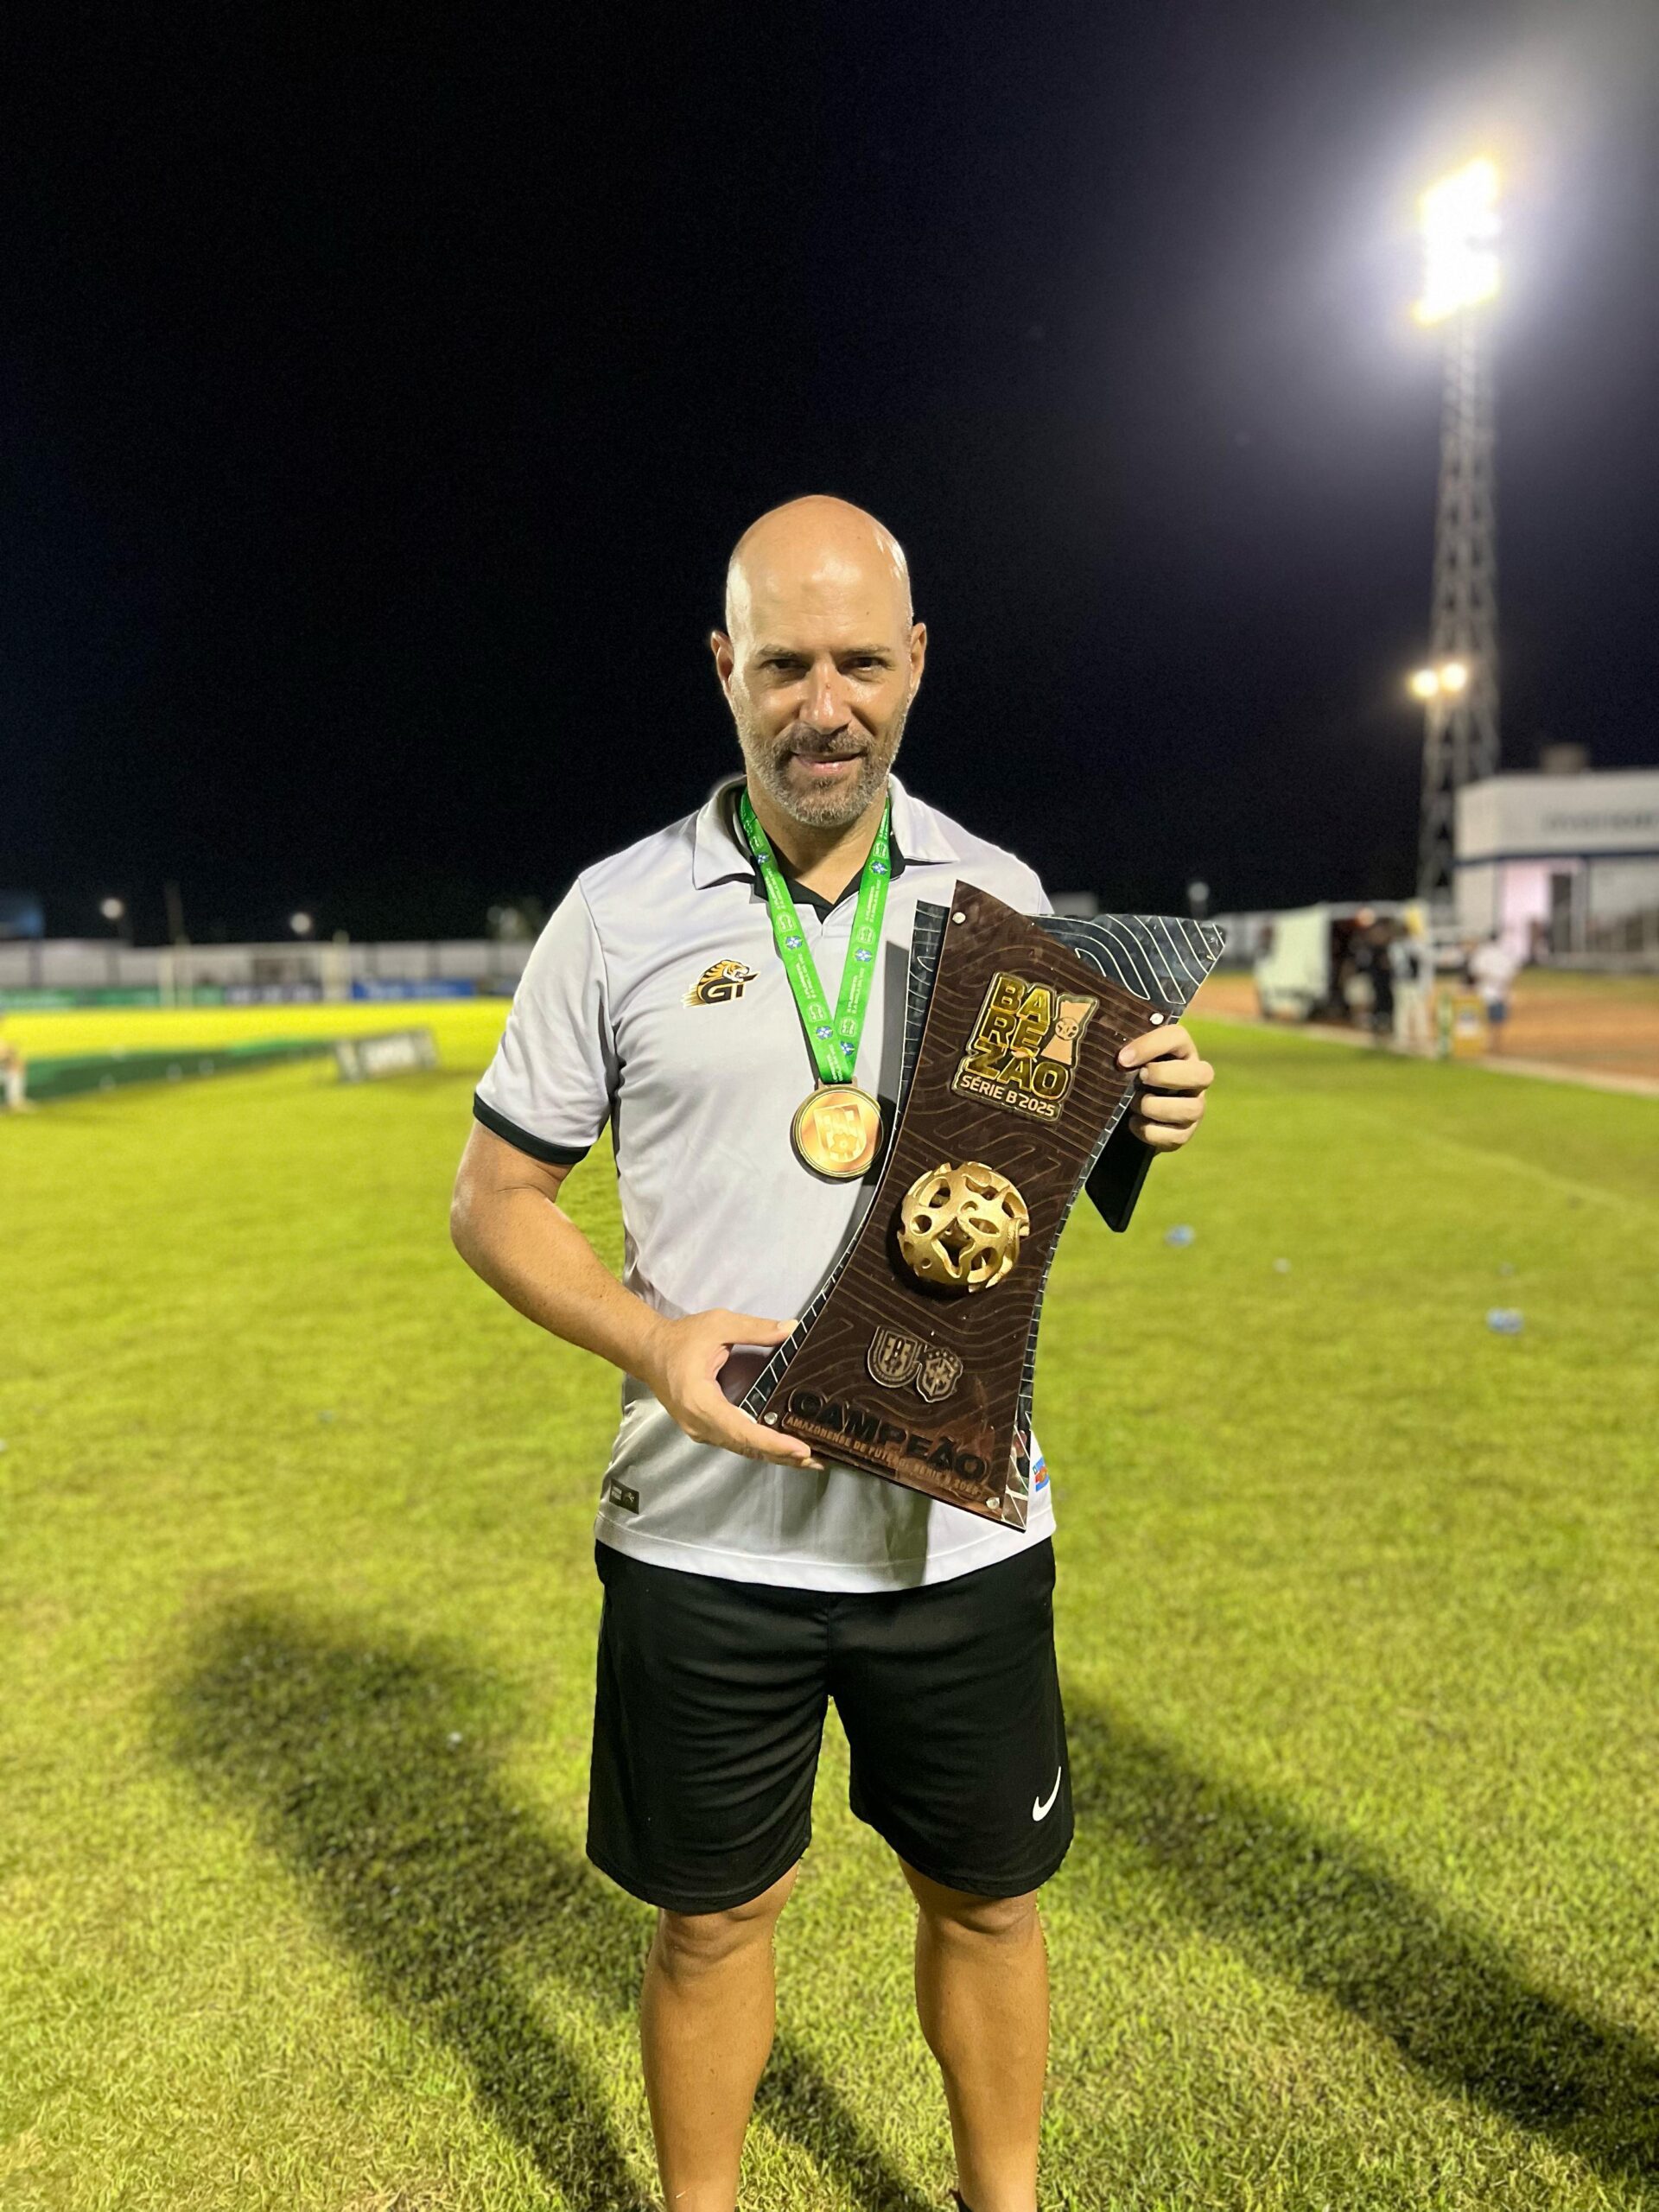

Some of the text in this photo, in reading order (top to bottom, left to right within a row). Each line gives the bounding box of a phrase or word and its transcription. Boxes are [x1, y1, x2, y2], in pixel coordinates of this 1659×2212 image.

[960, 1075, 1055, 1116] SÉRIE B 2025
[786, 1416, 851, 1447] AMAZONENSE
[853, 1440, 867, 1452] DE
[792, 1391, 987, 1481] CAMPEÃO
